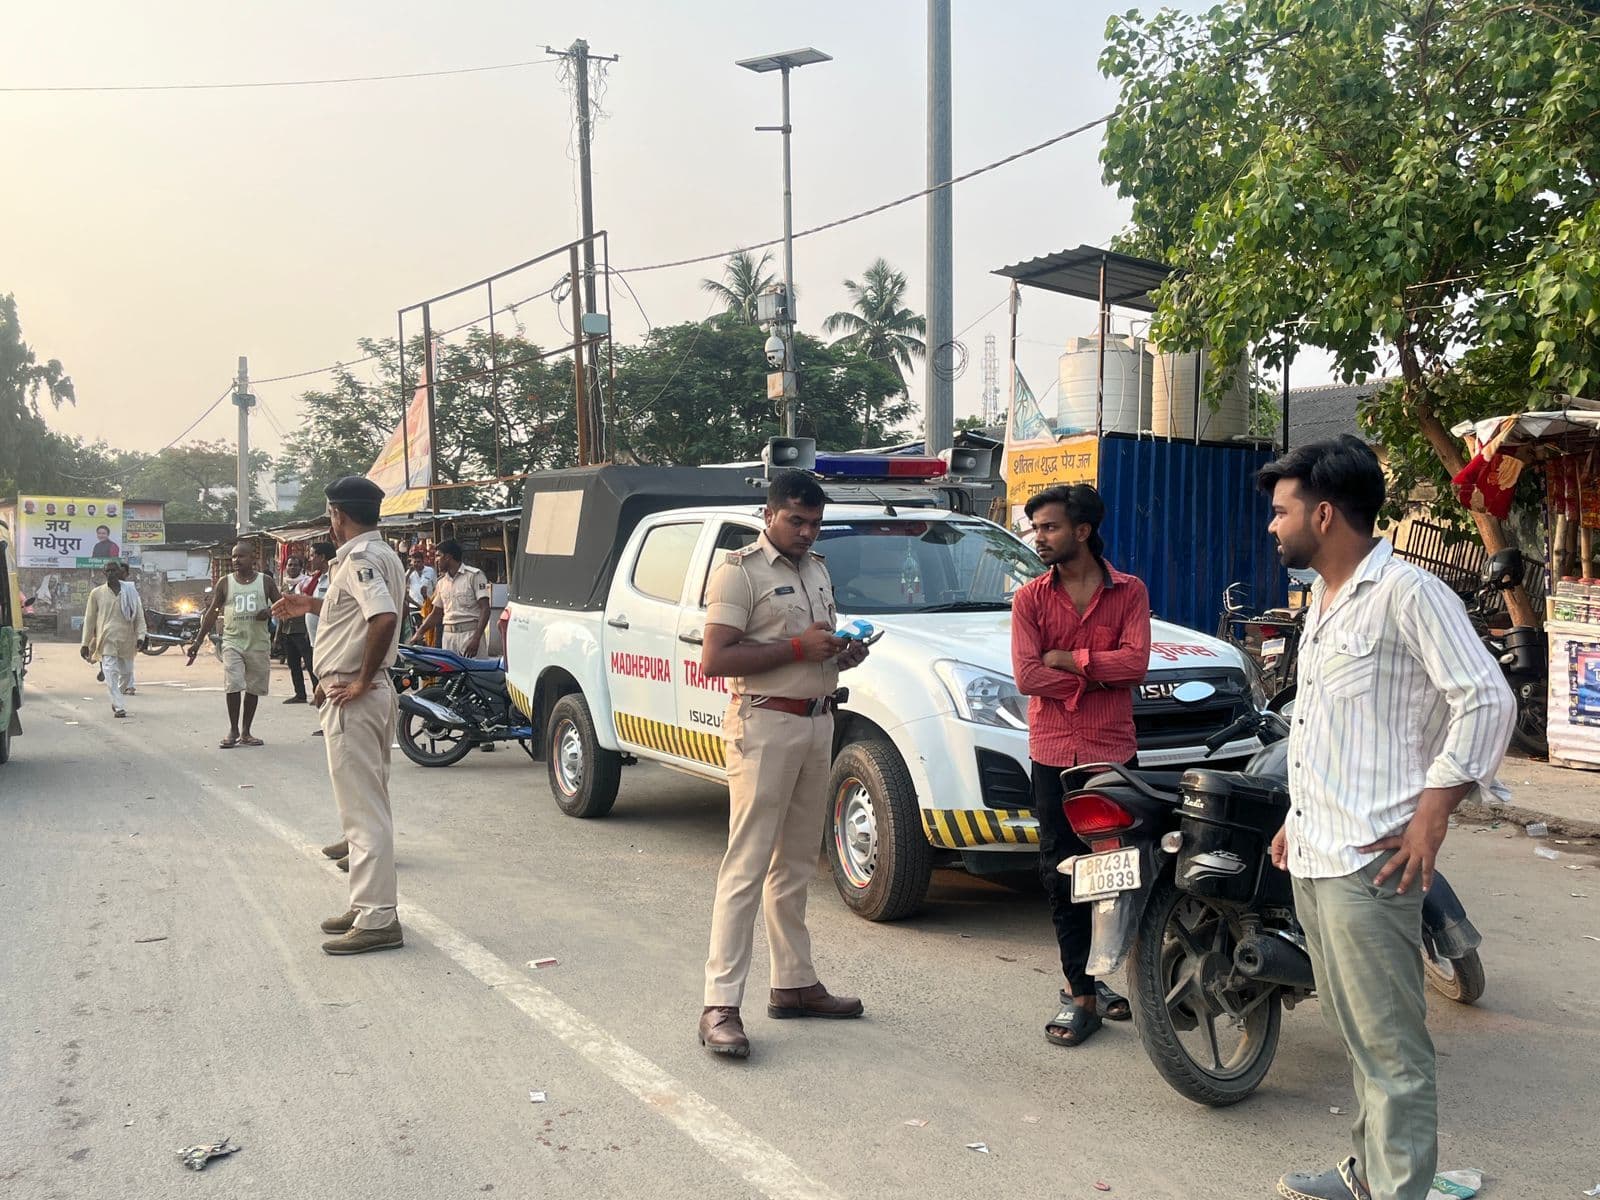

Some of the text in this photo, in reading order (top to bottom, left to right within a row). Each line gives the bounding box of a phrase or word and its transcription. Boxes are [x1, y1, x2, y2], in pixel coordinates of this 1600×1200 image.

[1013, 454, 1034, 475] शीतल
[1040, 455, 1058, 475] शुद्ध
[1060, 450, 1076, 469] पेय
[1076, 453, 1092, 469] जल
[45, 519, 71, 533] जय
[32, 533, 82, 554] मधेपुरा
[235, 593, 257, 613] 06
[610, 651, 671, 683] MADHEPURA
[1139, 683, 1181, 700] ISU
[689, 709, 721, 728] ISUZU
[1086, 852, 1132, 876] BR43A
